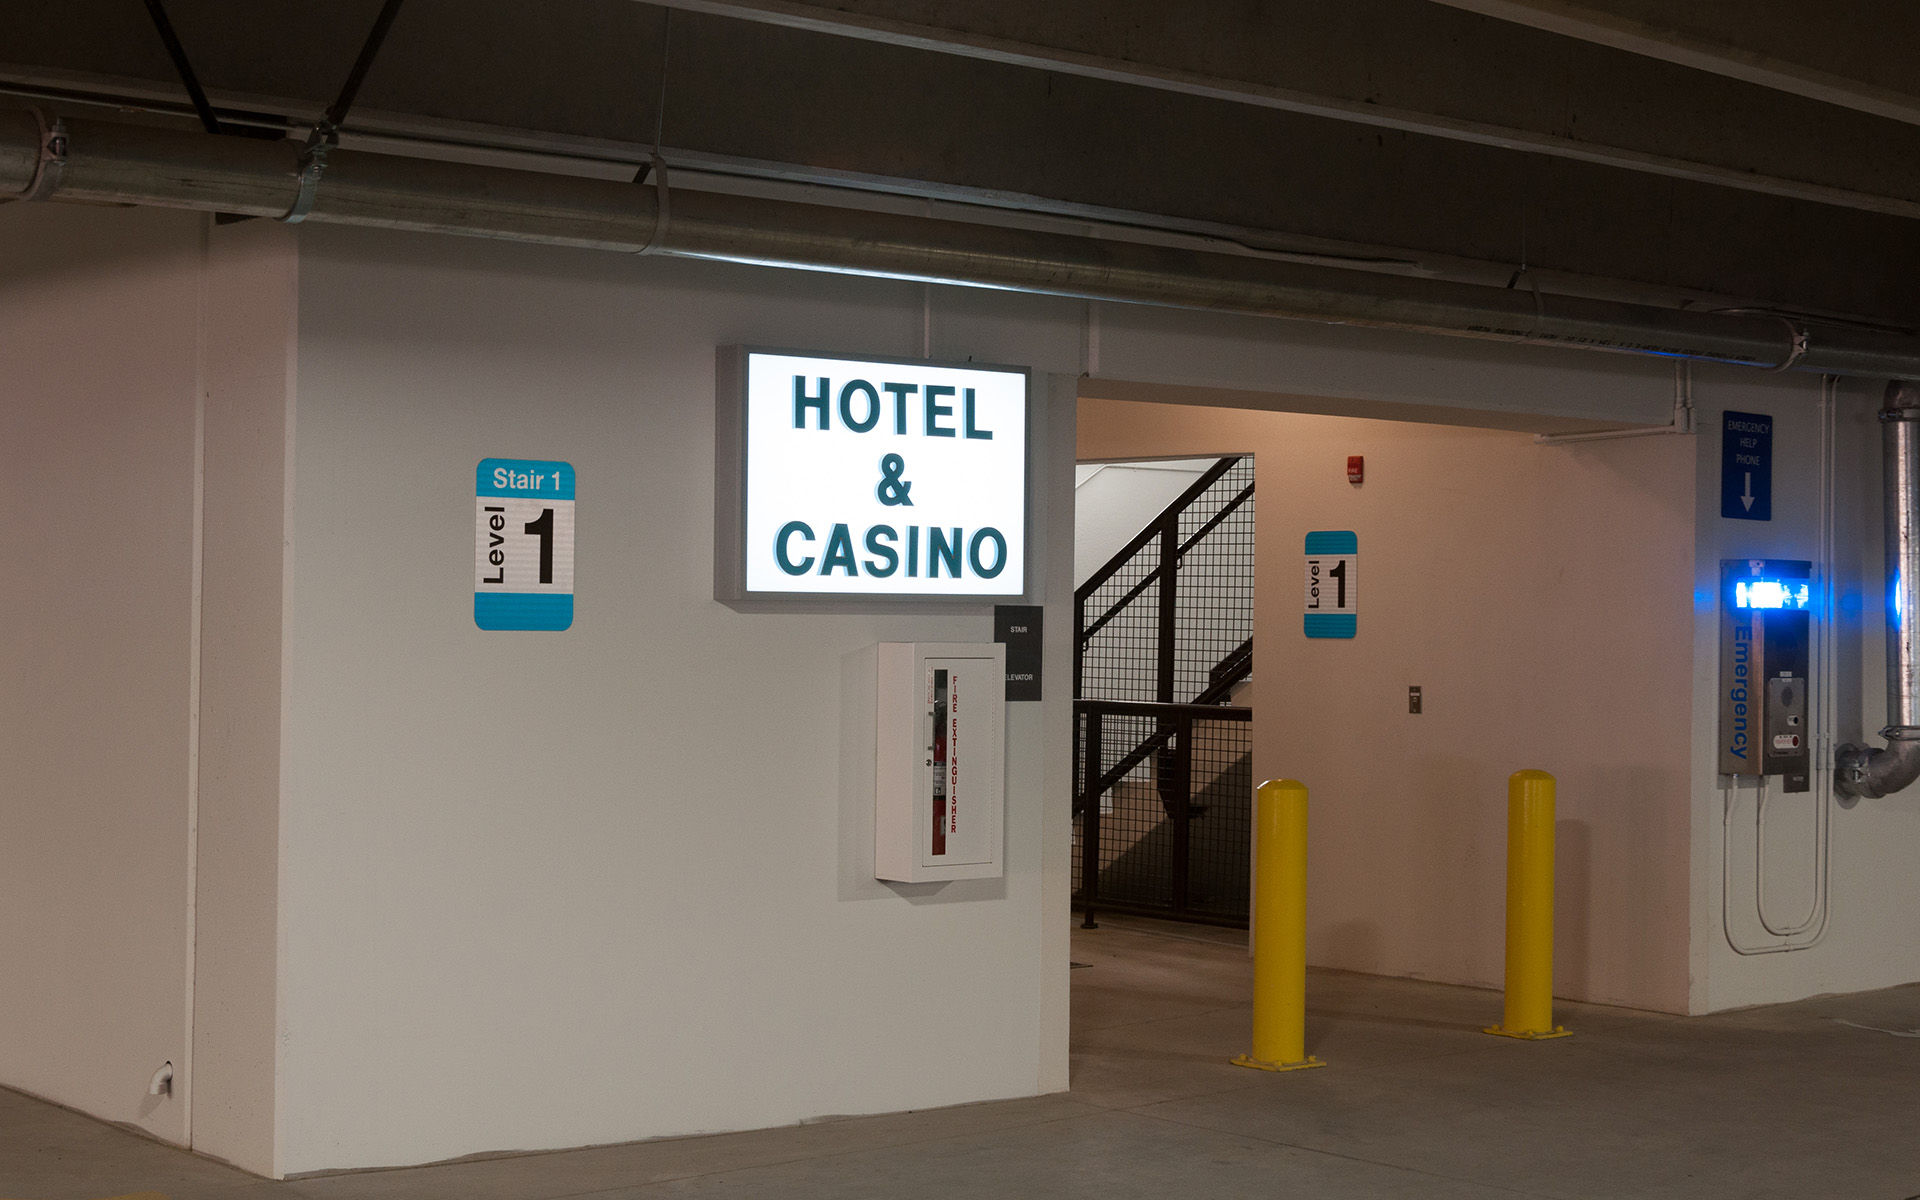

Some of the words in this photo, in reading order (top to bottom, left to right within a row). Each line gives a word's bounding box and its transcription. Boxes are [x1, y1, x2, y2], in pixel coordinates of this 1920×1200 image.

[792, 375, 993, 440] HOTEL
[1728, 420, 1770, 434] EMERGENCY
[1736, 453, 1760, 466] PHONE
[1740, 437, 1758, 448] HELP
[493, 468, 544, 490] Stair
[551, 471, 561, 491] 1
[874, 453, 914, 506] &
[483, 506, 505, 584] Level
[524, 508, 554, 584] 1
[773, 520, 1008, 579] CASINO
[1308, 560, 1320, 609] Level
[1329, 560, 1346, 608] 1
[1730, 625, 1752, 760] Emergency
